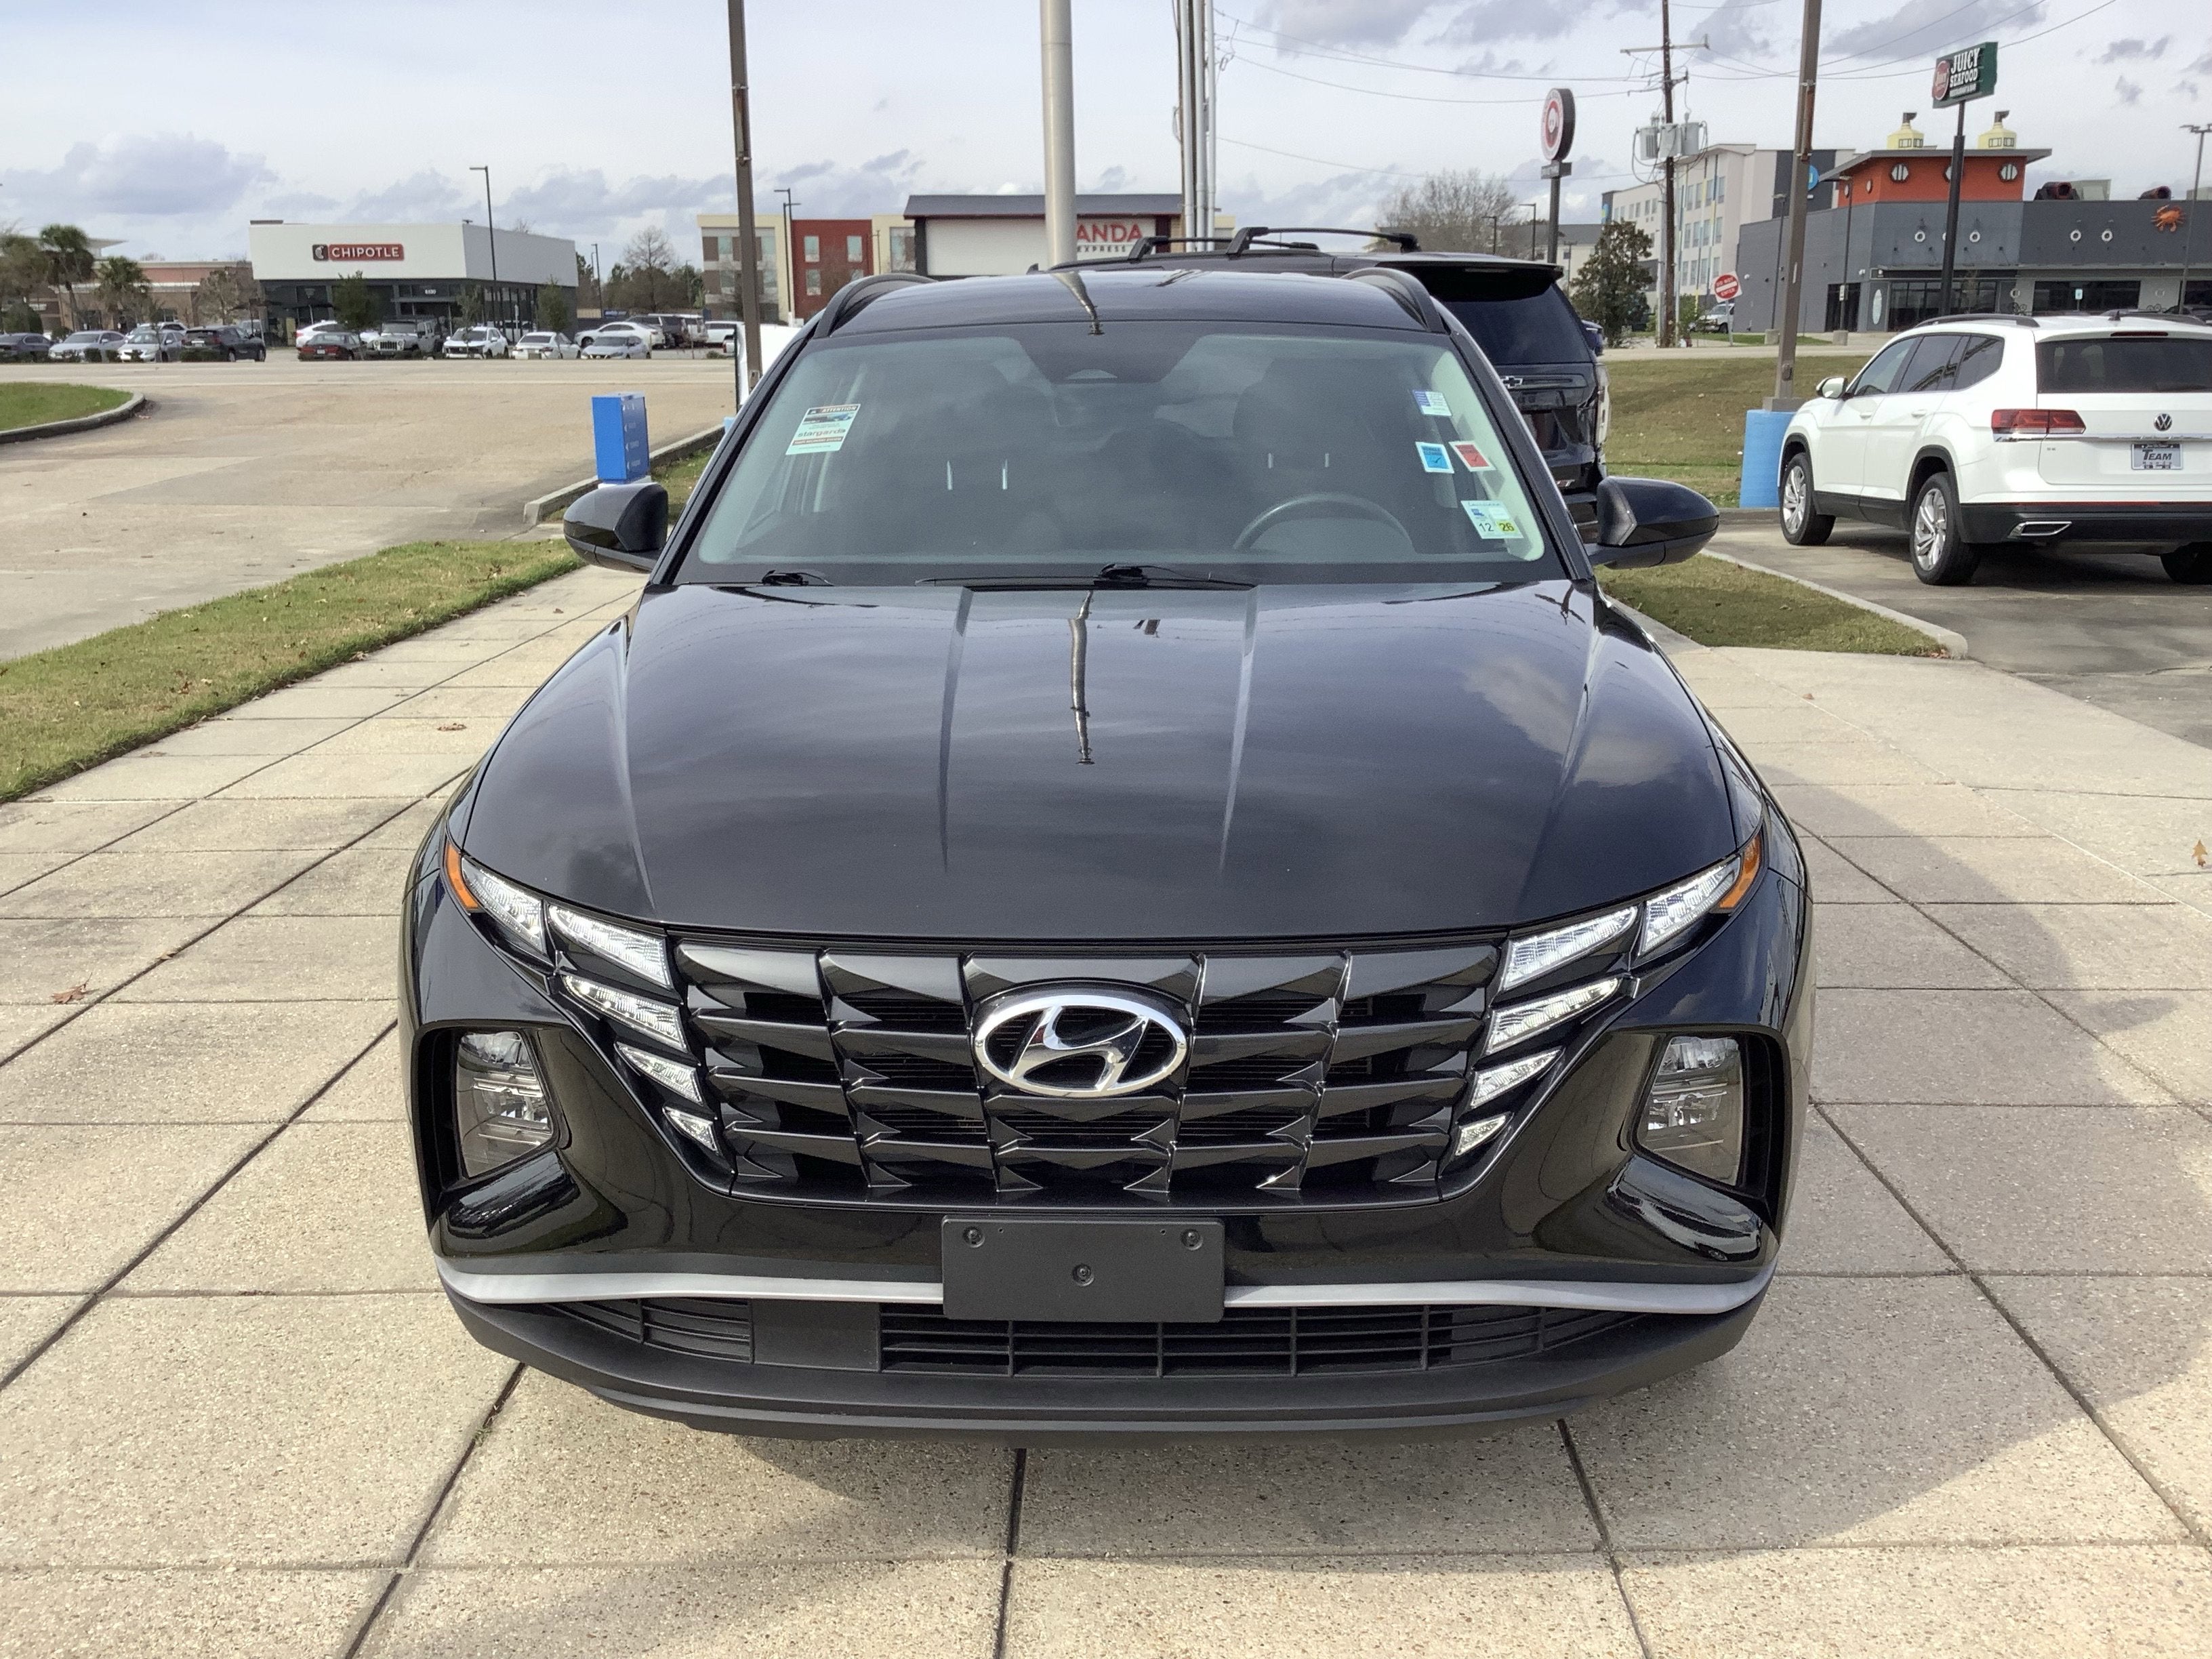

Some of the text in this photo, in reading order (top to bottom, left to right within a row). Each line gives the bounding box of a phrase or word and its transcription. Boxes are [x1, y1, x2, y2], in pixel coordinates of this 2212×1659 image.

[1951, 47, 1980, 75] JUICY
[1950, 68, 1978, 88] SEAFOOD
[1076, 224, 1142, 243] ANDA
[331, 247, 400, 258] CHIPOTLE
[2142, 449, 2173, 460] TEAM
[1479, 523, 1515, 532] 12 26
